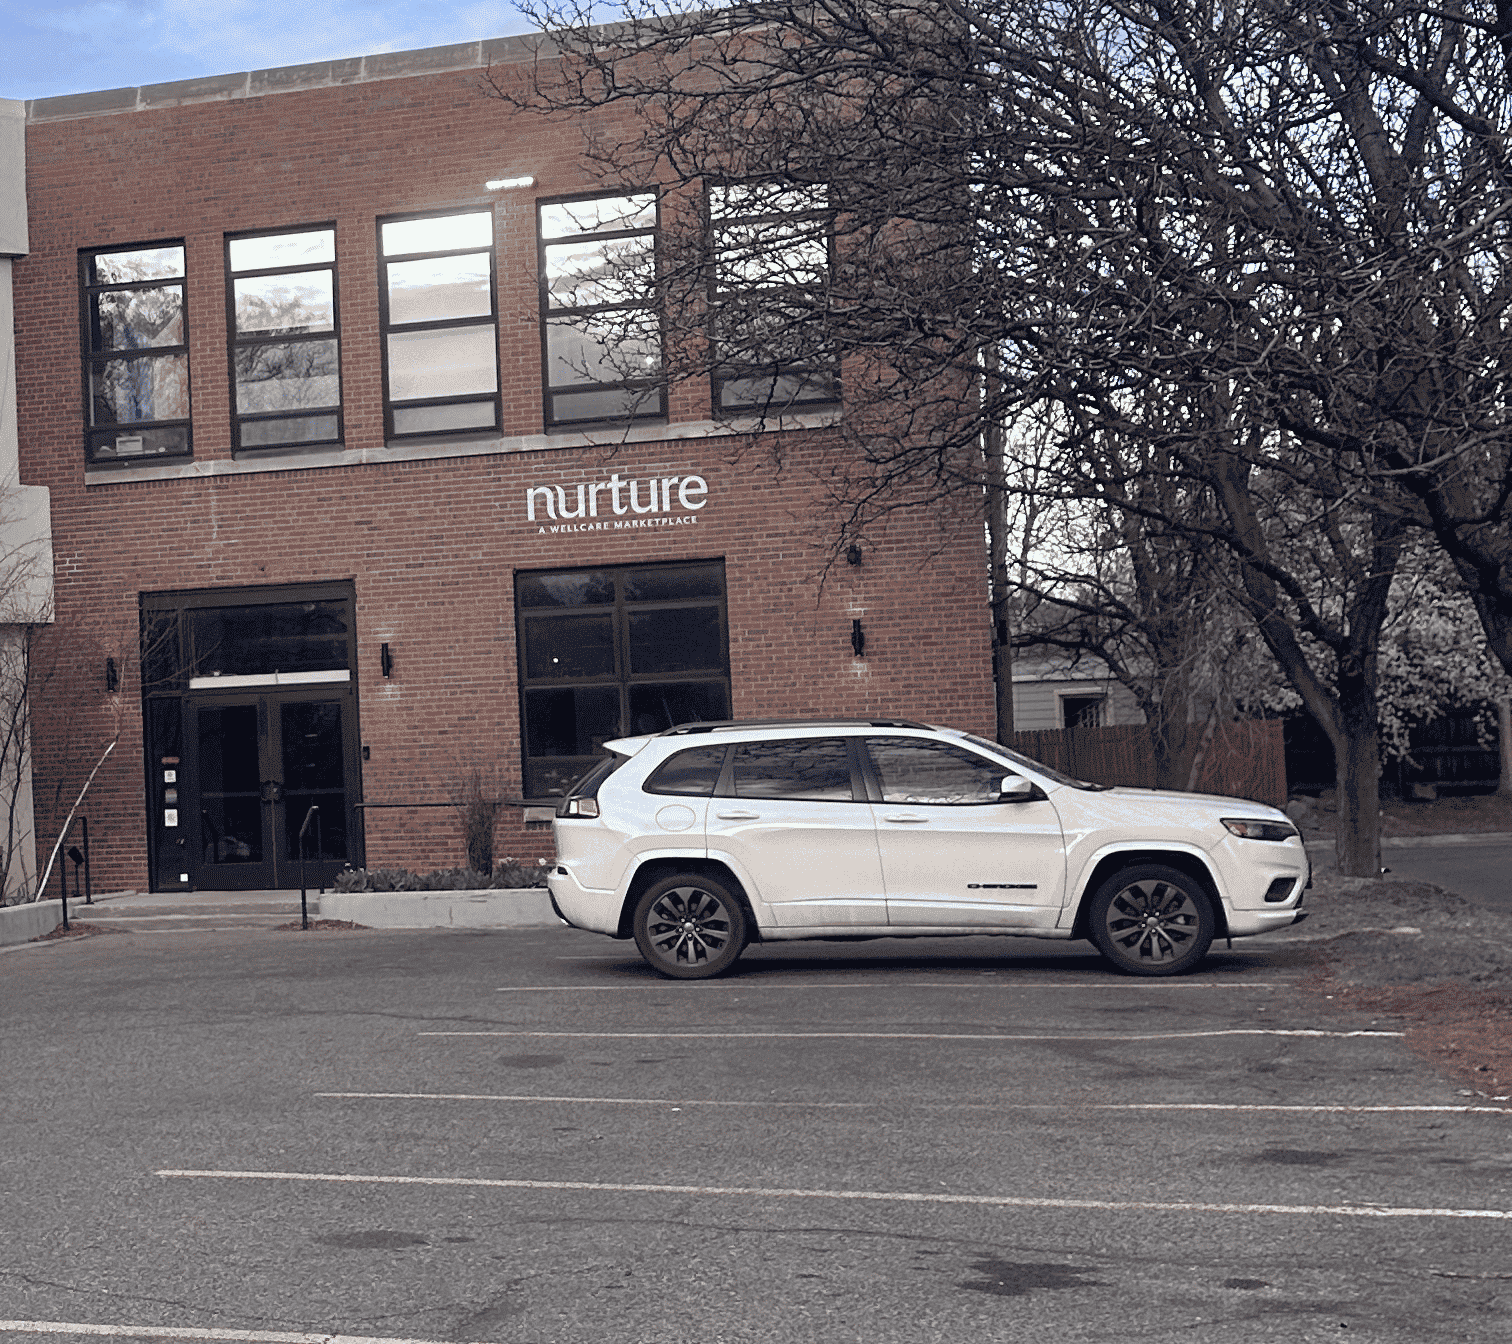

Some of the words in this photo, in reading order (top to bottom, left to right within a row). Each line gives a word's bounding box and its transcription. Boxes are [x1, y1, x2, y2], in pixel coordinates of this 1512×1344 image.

[526, 473, 709, 521] nurture
[538, 526, 546, 534] A
[550, 521, 609, 533] WELLCARE
[614, 515, 698, 529] MARKETPLACE
